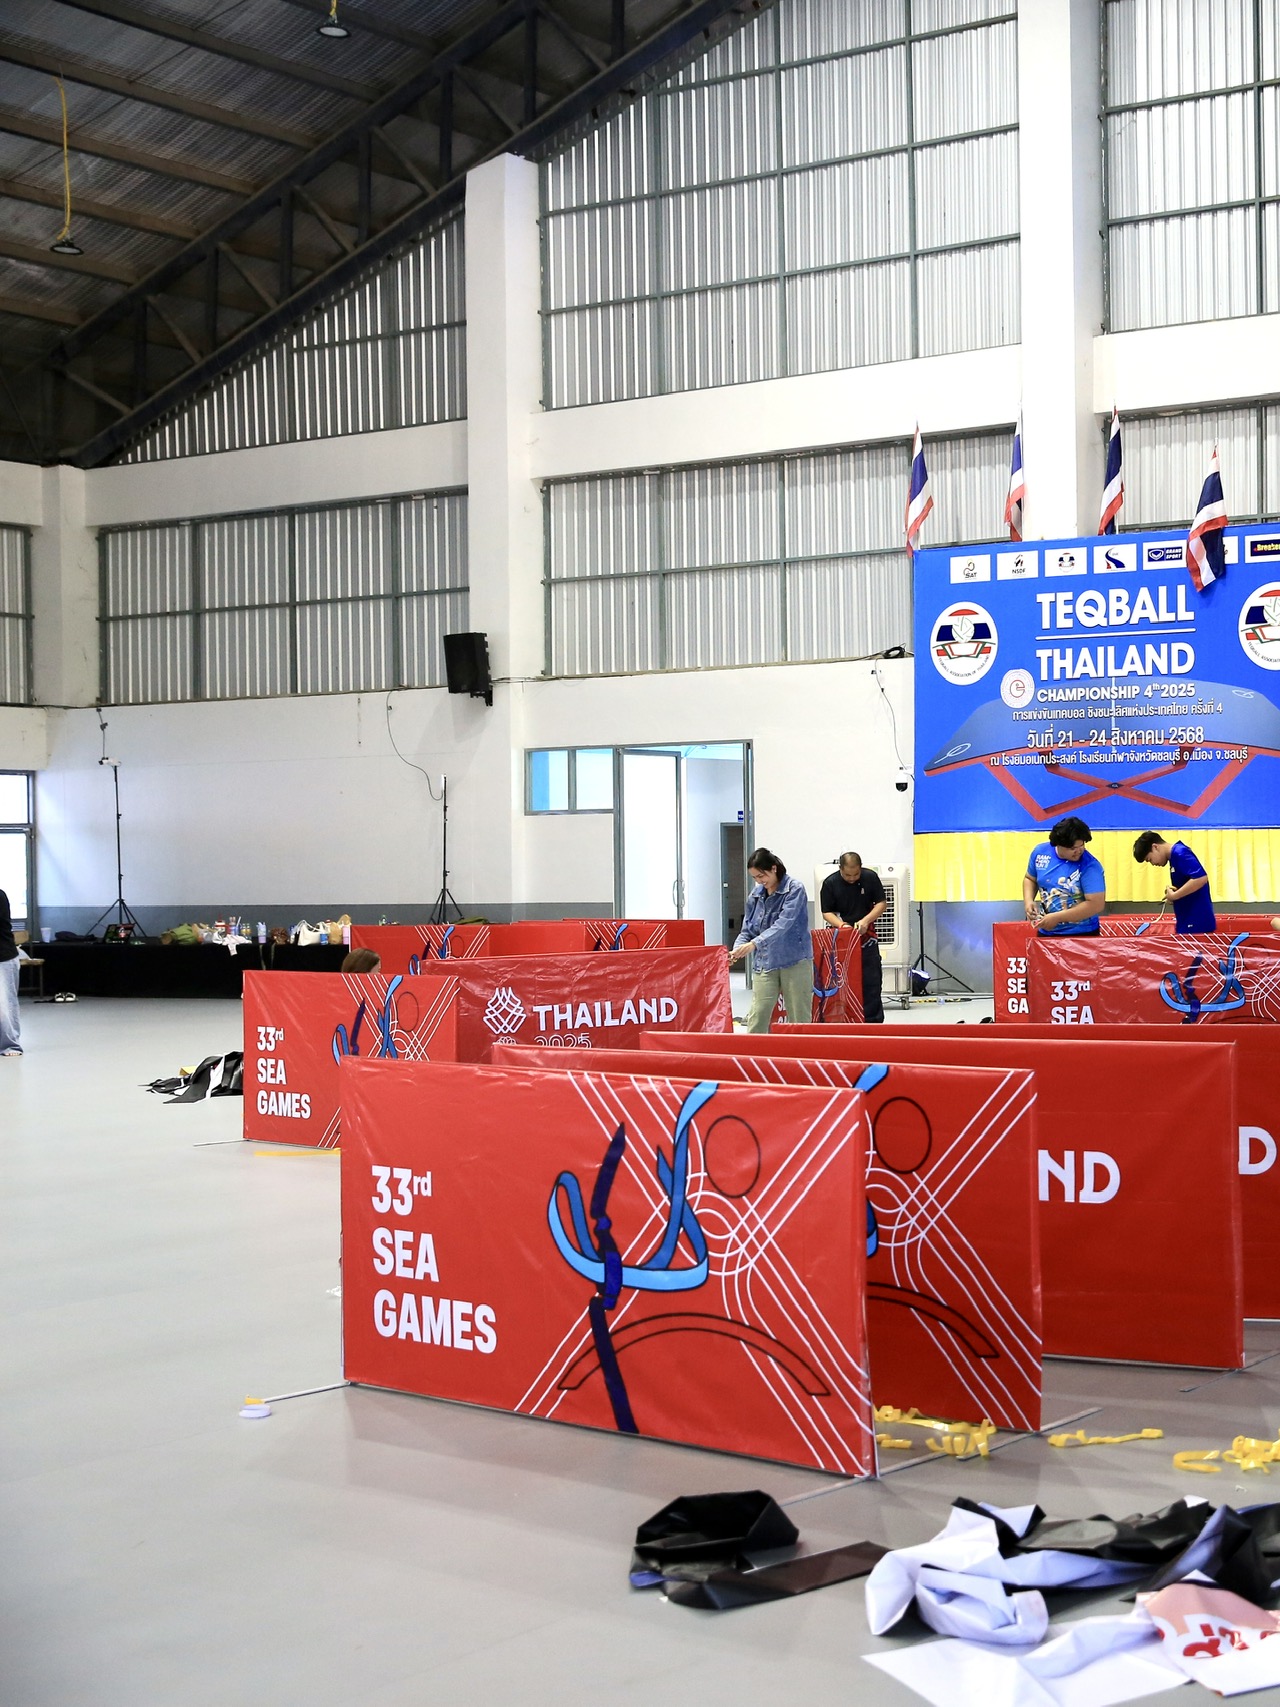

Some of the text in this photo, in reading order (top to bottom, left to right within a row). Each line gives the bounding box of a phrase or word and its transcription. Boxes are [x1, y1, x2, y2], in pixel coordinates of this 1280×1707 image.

[1036, 584, 1195, 630] TEQBALL
[1036, 642, 1195, 681] THAILAND
[1036, 685, 1140, 702] CHAMPIONSHIP
[1216, 702, 1223, 714] 4
[1027, 724, 1053, 749] วันที่
[1057, 730, 1073, 747] 21
[1089, 729, 1106, 747] 24
[1111, 727, 1165, 746] สิงหาคม
[1169, 726, 1204, 744] 2568
[990, 756, 999, 766] ณ
[1183, 747, 1213, 761] อ.เมือง
[1215, 746, 1248, 764] จ.ชลบุรี
[1050, 980, 1091, 1002] 33rd
[532, 996, 678, 1032] THAILAND
[1051, 1005, 1095, 1024] SEA
[257, 1026, 284, 1052] 33rd
[257, 1057, 287, 1085] SEA
[257, 1089, 311, 1119] GAMES
[371, 1165, 432, 1216] 33rd
[372, 1226, 440, 1283] SEA
[373, 1288, 498, 1355] GAMES
